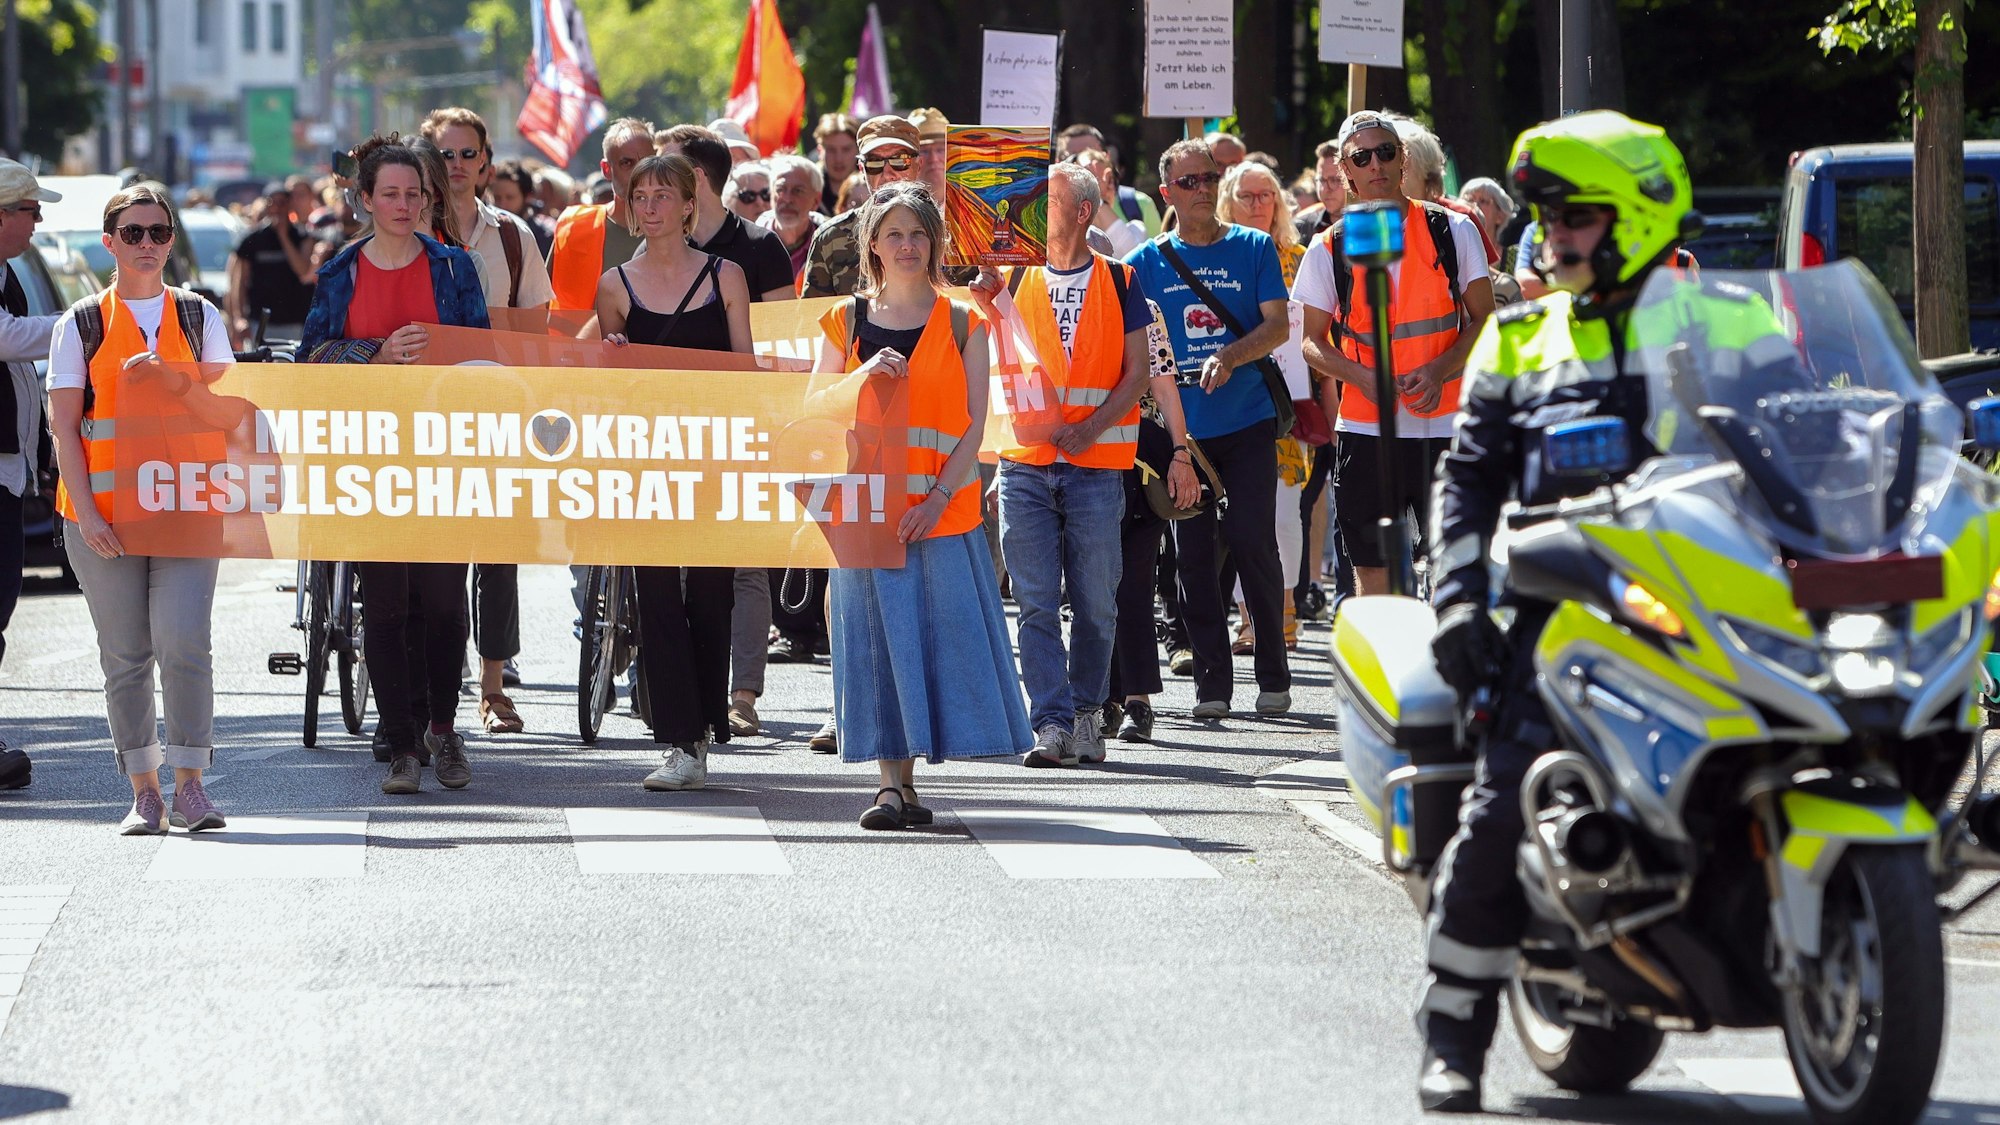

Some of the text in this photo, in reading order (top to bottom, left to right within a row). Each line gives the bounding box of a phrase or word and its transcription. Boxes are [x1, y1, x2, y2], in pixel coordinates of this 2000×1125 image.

[1152, 14, 1165, 22] Ich
[1166, 14, 1180, 22] hab
[1154, 26, 1181, 34] geredet
[1155, 63, 1226, 73] Jetzt kleb ich
[1164, 80, 1215, 90] am Leben.
[1192, 267, 1212, 276] orld's
[1213, 267, 1228, 279] only
[1060, 326, 1071, 342] &
[1187, 344, 1201, 353] Das
[255, 408, 770, 463] MEHR DEMOKRATIE:
[137, 460, 886, 524] GESELLSCHAFTSRAT JETZT!
